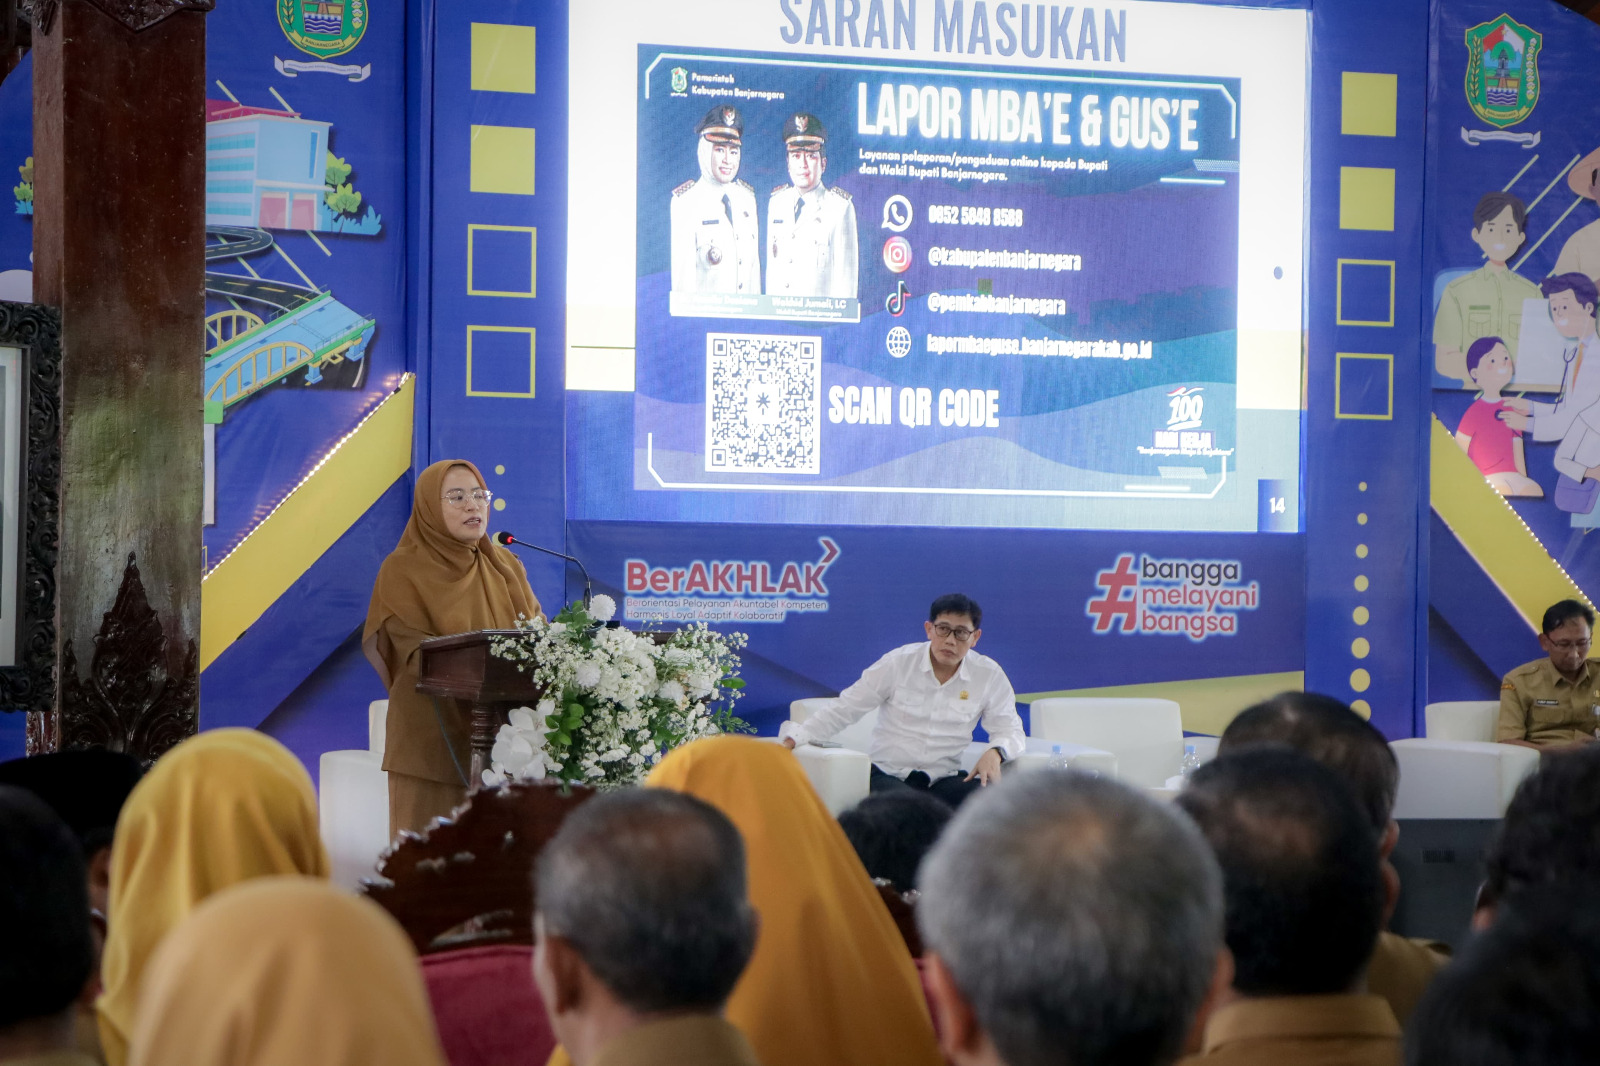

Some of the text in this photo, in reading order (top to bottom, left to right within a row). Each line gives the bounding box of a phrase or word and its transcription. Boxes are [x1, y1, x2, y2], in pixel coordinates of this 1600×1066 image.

[780, 0, 1126, 62] SARAN MASUKAN
[692, 72, 735, 83] Pemerintah
[692, 85, 733, 98] Kabupaten
[734, 87, 784, 101] Banjarnegara
[858, 82, 1199, 151] LAPOR MBA'E & GUS'E
[859, 148, 900, 162] Layanan
[1010, 156, 1039, 168] online
[1040, 156, 1076, 172] kepada
[1078, 159, 1108, 173] Bupati
[859, 163, 1008, 183] dan Wakil Bupati Banjarnegara.
[928, 246, 1082, 272] @kabupatenbanjarnegara
[927, 292, 1066, 316] @pemkabbanjarnegara
[828, 385, 1000, 428] SCAN QR CODE
[1167, 394, 1203, 425] 100
[1269, 497, 1286, 513] 14
[627, 561, 826, 593] BerAKHLAK
[1142, 557, 1238, 586] bangga
[626, 598, 827, 611] Berorientasi Pelayanan Akuntabel Kompeten
[1142, 584, 1256, 612] melayani
[626, 610, 783, 621] Harmonis Loyal Adaptif Kolaboratif
[1142, 610, 1234, 638] bangsa
